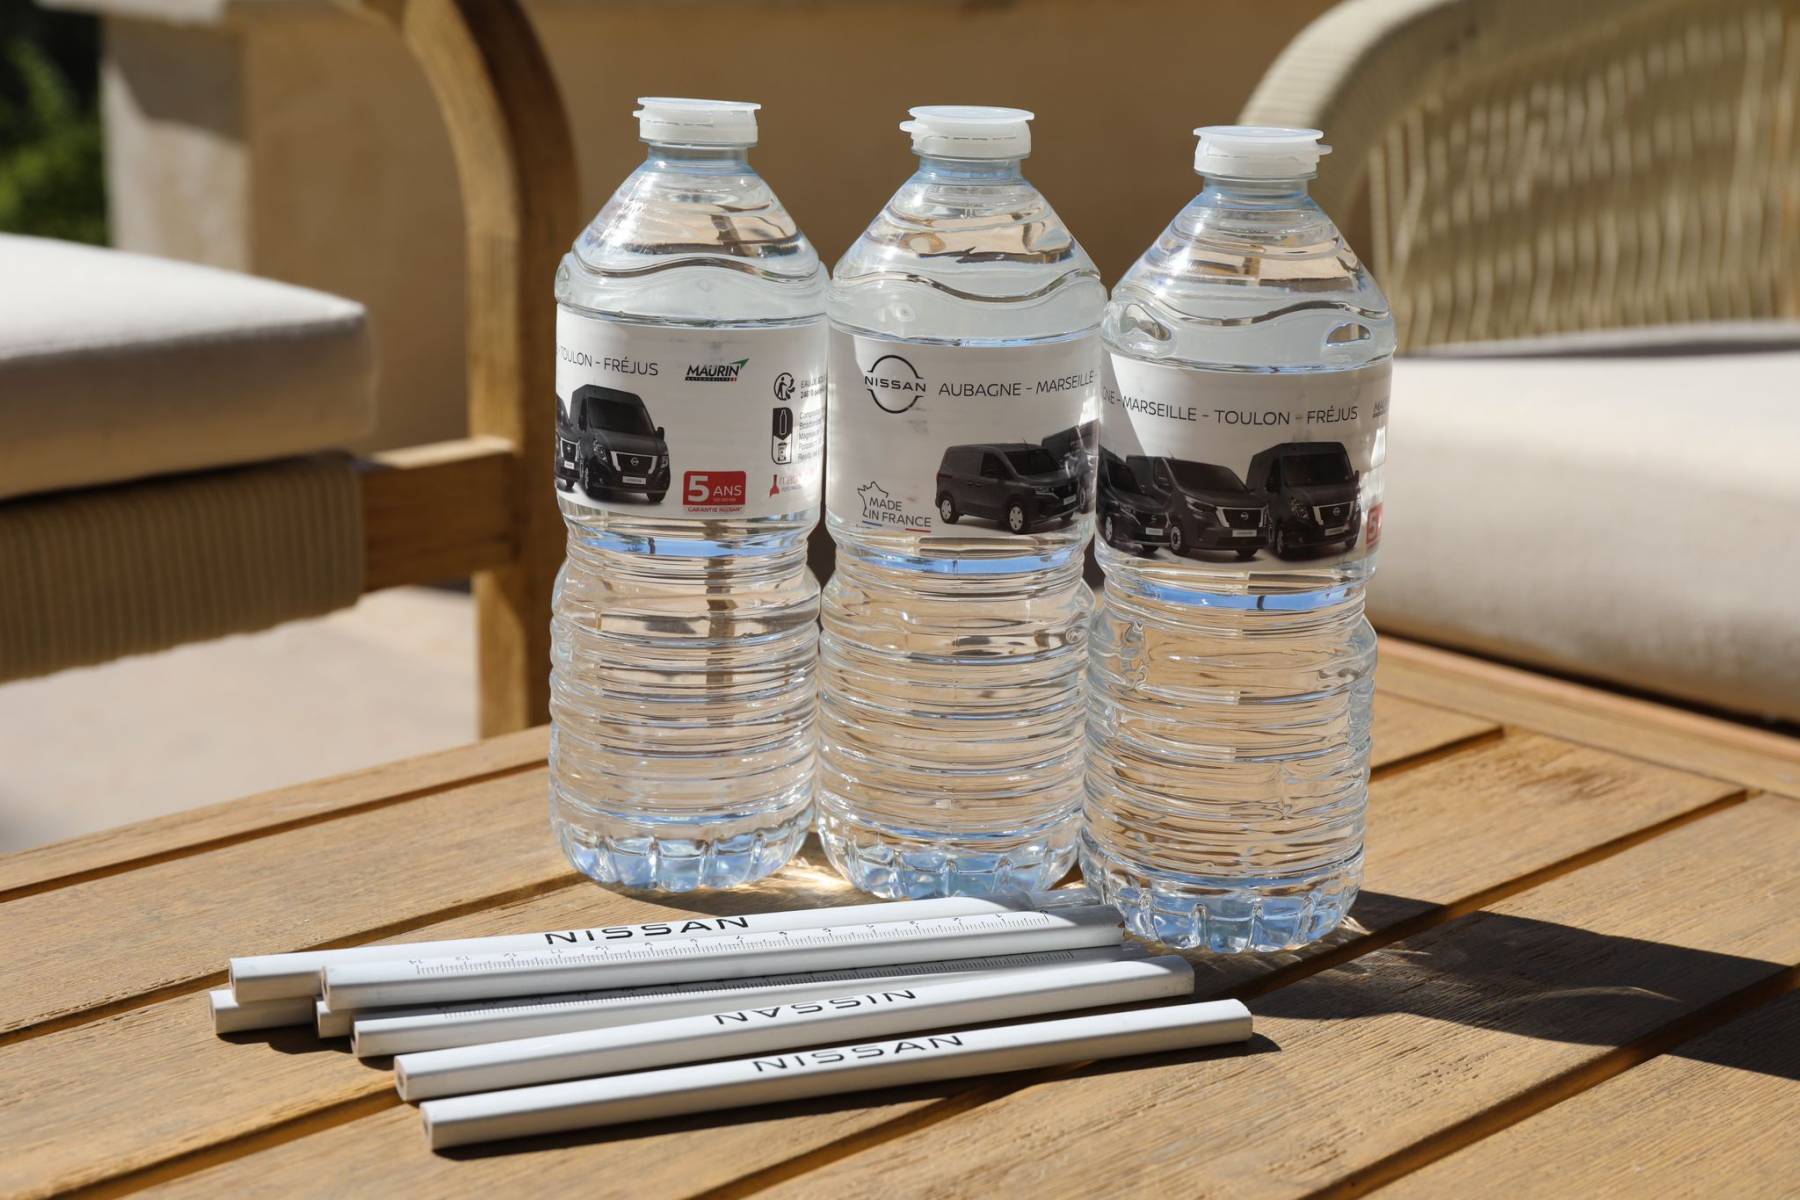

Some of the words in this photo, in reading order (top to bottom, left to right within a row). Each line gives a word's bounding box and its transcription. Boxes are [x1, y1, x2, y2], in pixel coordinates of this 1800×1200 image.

[603, 356, 659, 376] FRÉJUS
[686, 364, 740, 377] MAURIN
[864, 375, 926, 393] NISSAN
[938, 382, 1022, 397] AUBAGNE
[1036, 370, 1095, 395] MARSEILLE
[1122, 395, 1197, 421] MARSEILLE
[1214, 409, 1291, 426] TOULON
[1306, 405, 1359, 425] FRÉJUS
[687, 475, 710, 502] 5
[713, 485, 743, 497] ANS
[869, 496, 903, 512] MADE
[868, 509, 880, 521] IN
[881, 511, 932, 528] FRANCE
[544, 916, 749, 945] NISSAN
[714, 989, 916, 1025] NISSAN
[752, 1034, 964, 1073] NISSAN
